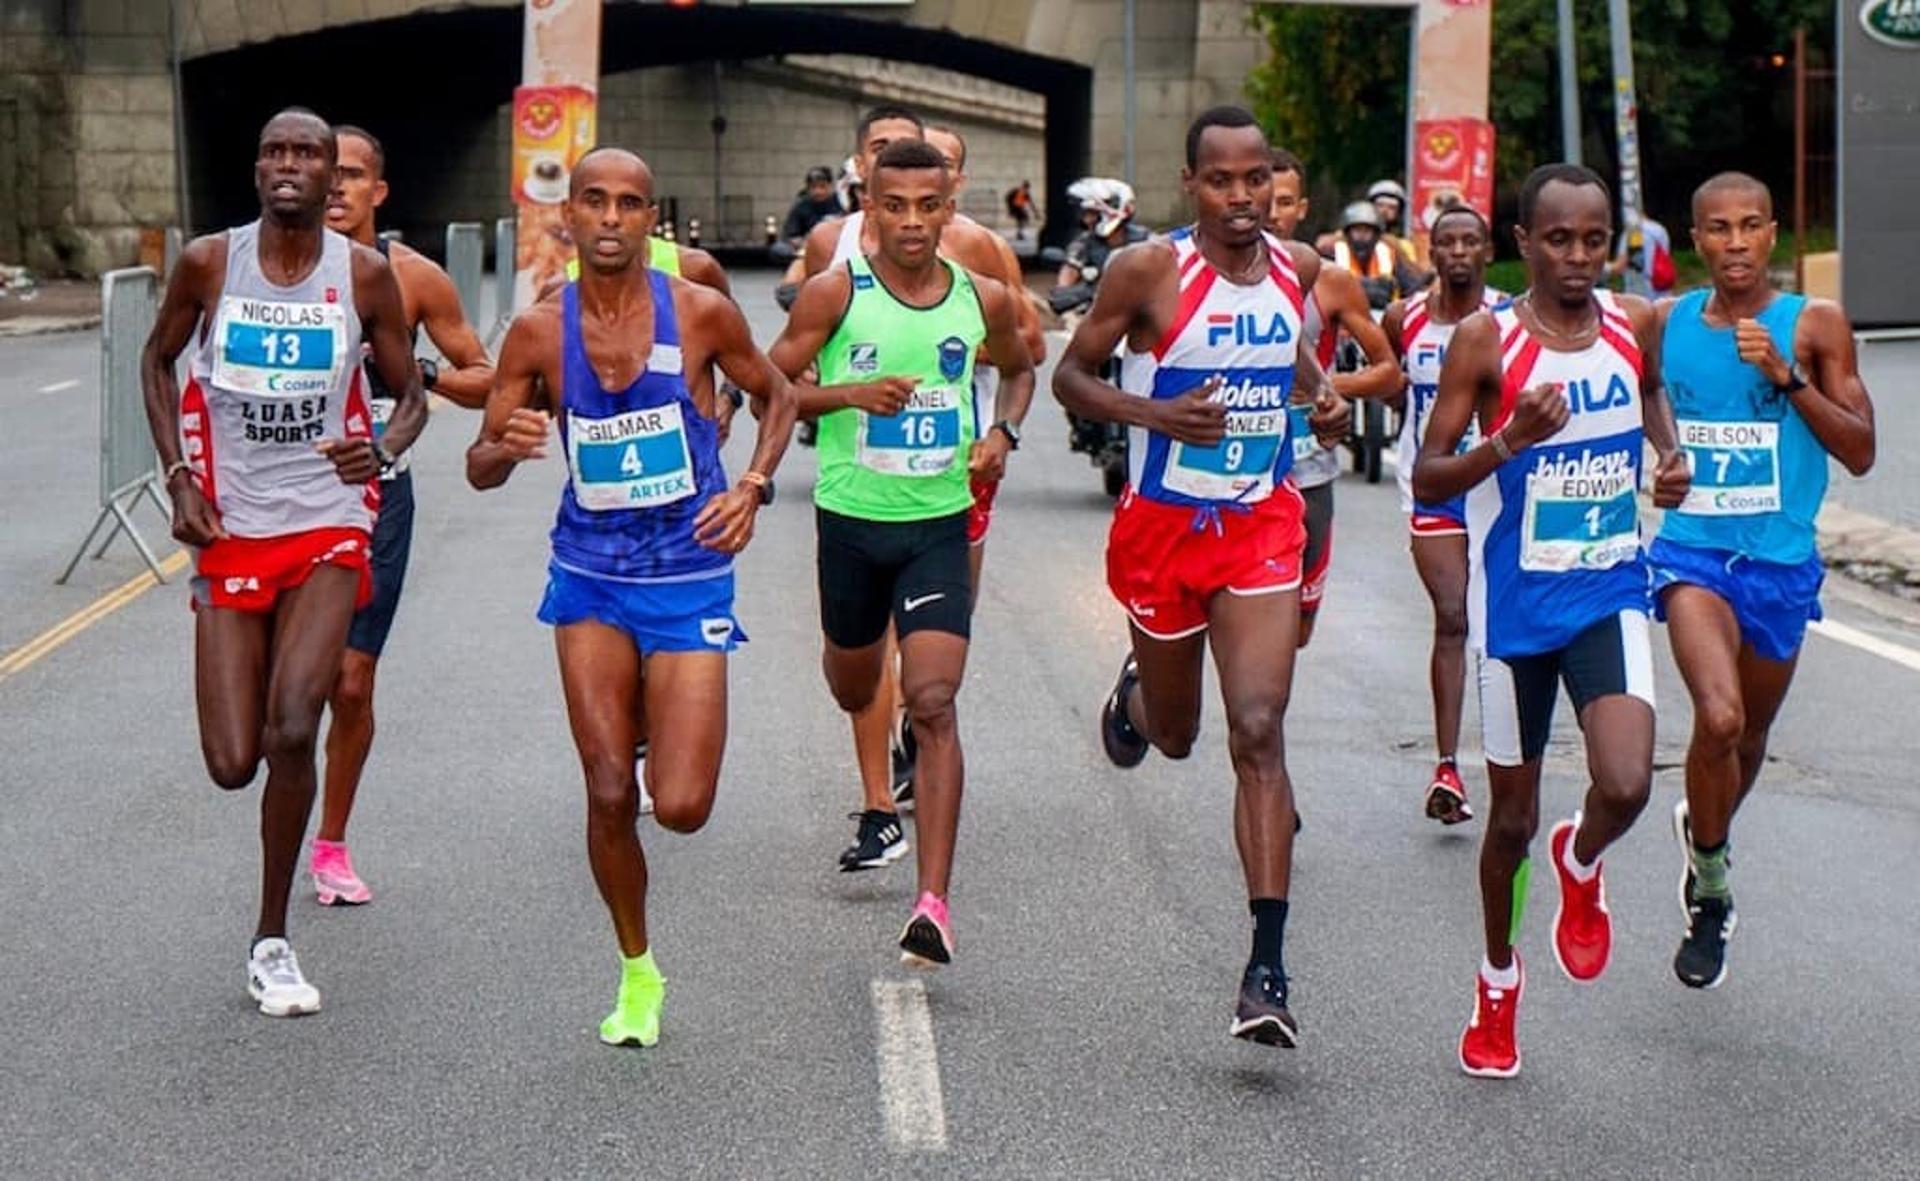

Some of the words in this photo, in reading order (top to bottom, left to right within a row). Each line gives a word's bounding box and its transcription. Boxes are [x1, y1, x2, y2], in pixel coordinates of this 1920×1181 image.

[241, 303, 324, 325] NICOLAS
[1207, 313, 1291, 346] FILA
[261, 332, 301, 365] 13
[905, 390, 946, 408] NIEL
[1556, 374, 1631, 415] ILA
[245, 419, 324, 443] SPORTS
[587, 413, 663, 442] GILMAR
[901, 416, 936, 446] 16
[1225, 414, 1274, 434] ANLEY
[1687, 425, 1762, 445] GEILSON
[620, 443, 644, 476] 4
[1226, 441, 1244, 471] 9
[1712, 452, 1731, 484] 7
[630, 478, 688, 499] ARTEX
[1584, 505, 1601, 537] 1
